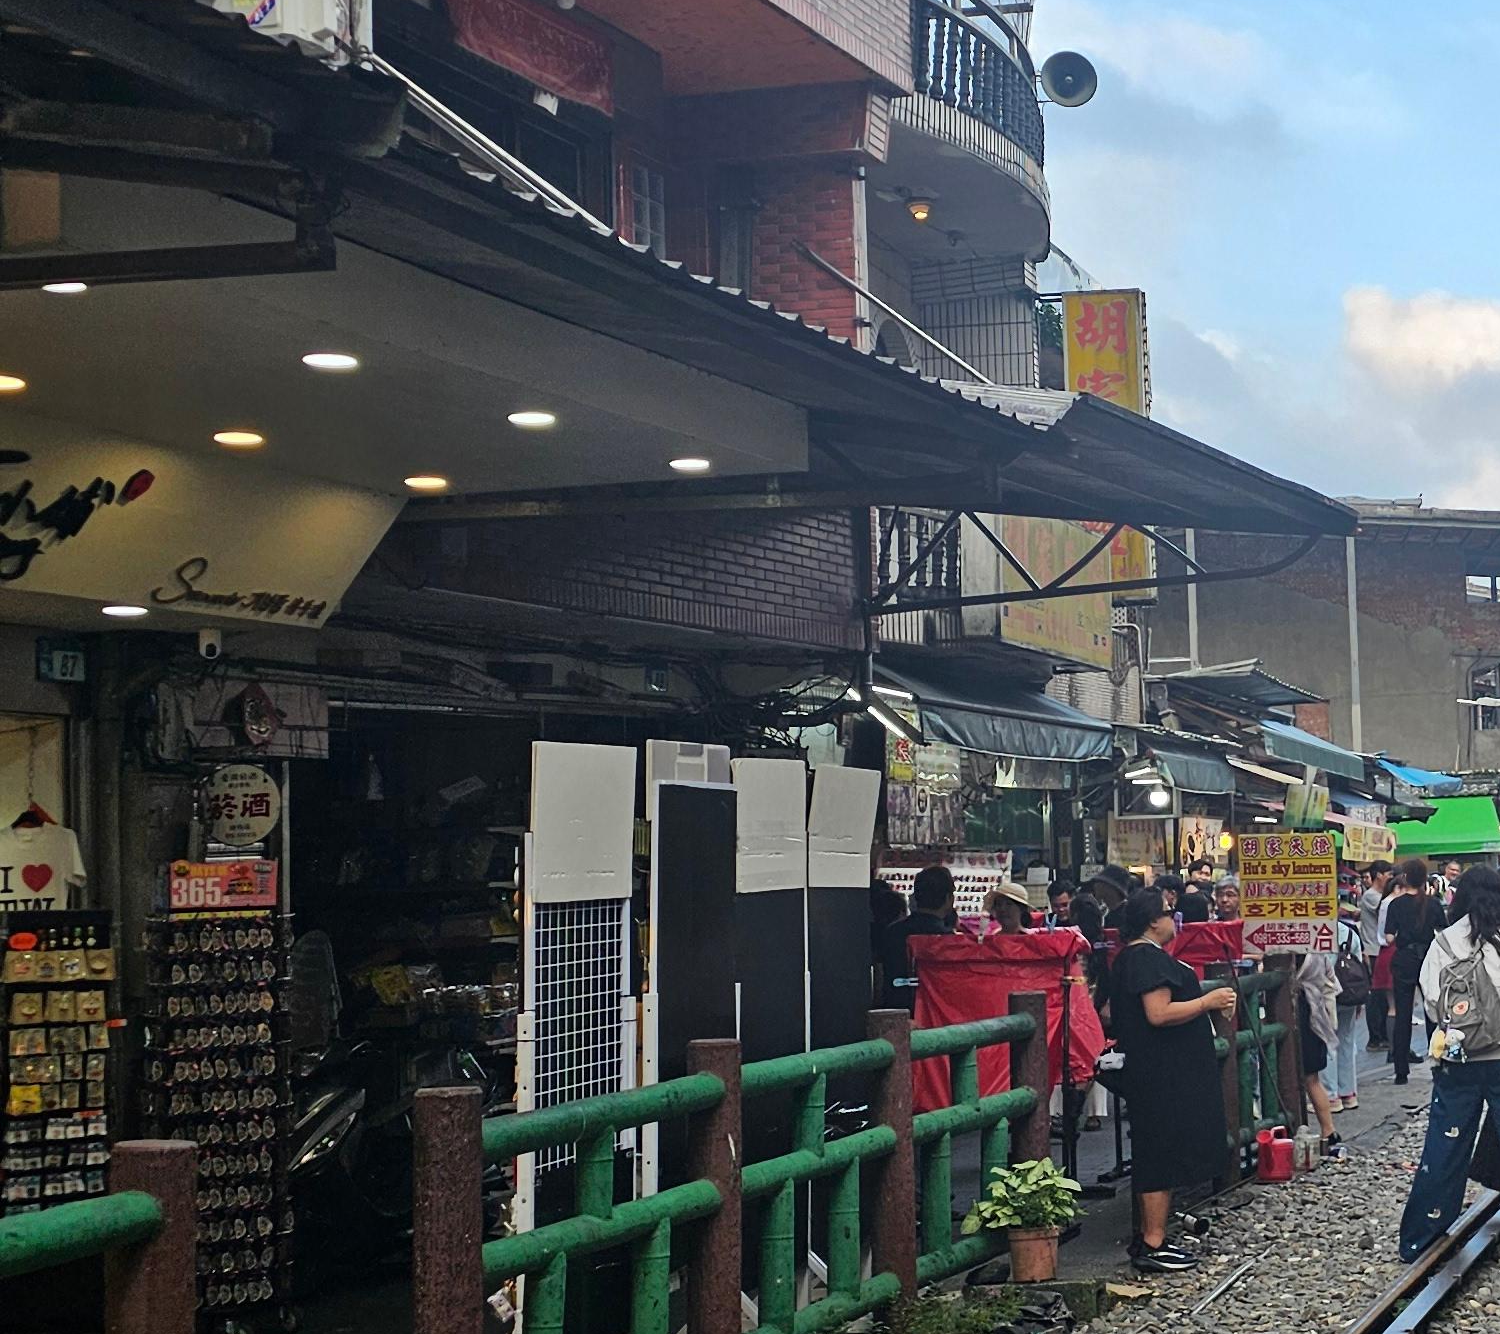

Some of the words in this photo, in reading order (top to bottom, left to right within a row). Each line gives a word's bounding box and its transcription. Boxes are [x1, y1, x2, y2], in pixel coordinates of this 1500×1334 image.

[1242, 835, 1331, 858] 胡家天燈
[1243, 861, 1267, 875] Hu's
[1271, 860, 1291, 877] sky
[1292, 861, 1332, 875] lantern
[1244, 900, 1333, 918] 호가천등
